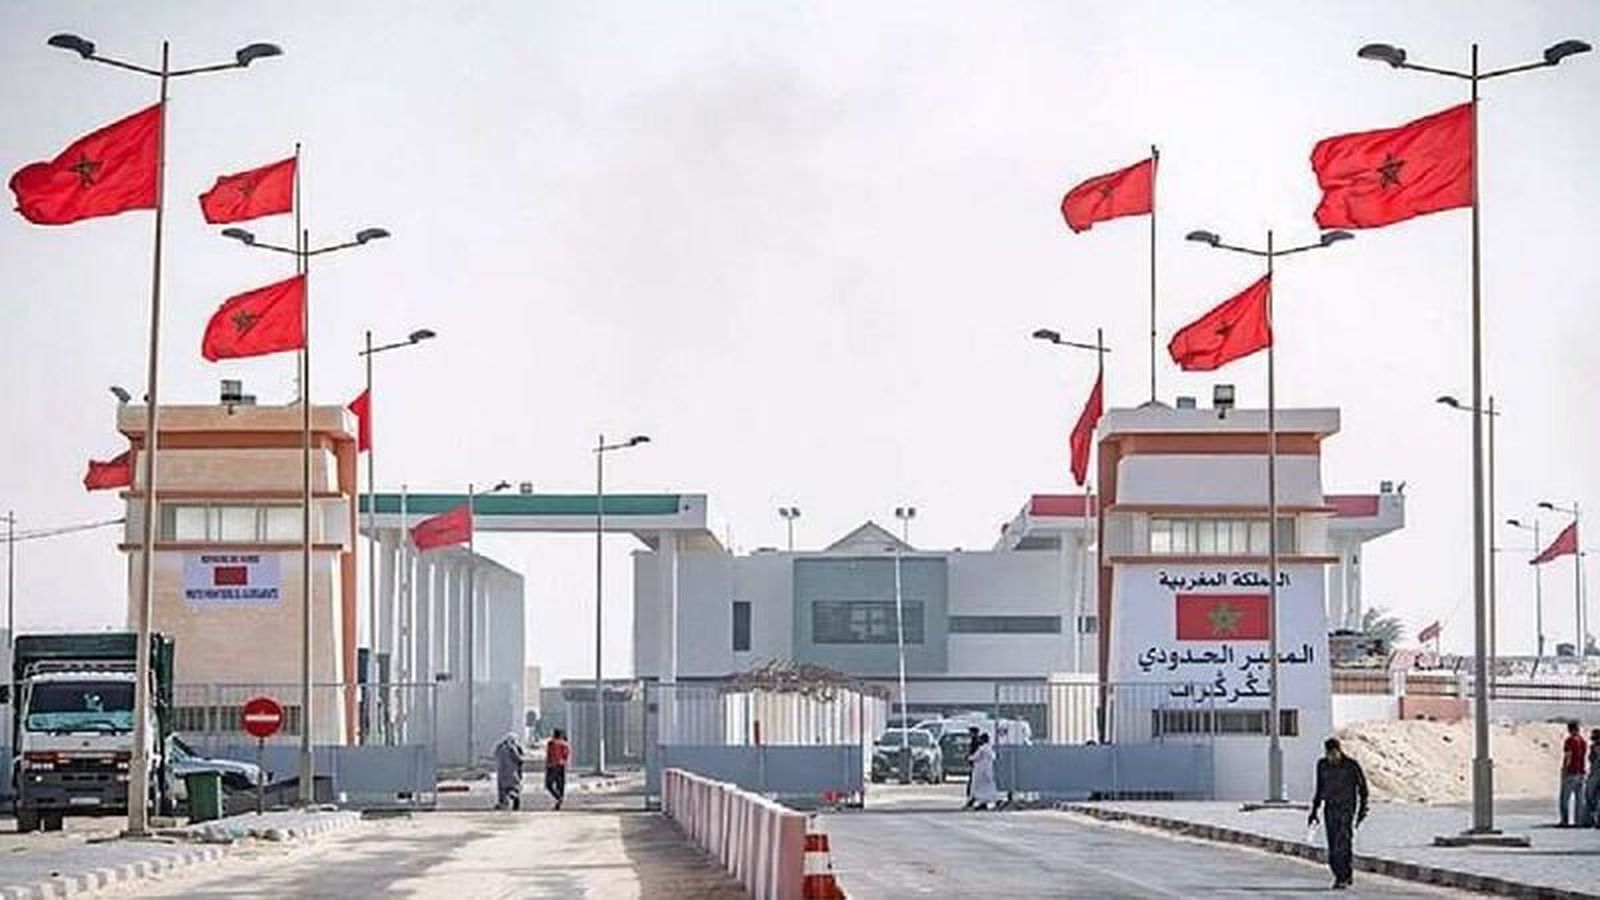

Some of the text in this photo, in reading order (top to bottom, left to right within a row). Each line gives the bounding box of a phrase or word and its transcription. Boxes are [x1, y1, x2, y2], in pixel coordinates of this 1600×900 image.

[1159, 571, 1290, 590] الملكة المغربية
[1138, 644, 1314, 672] المبر الحدودي
